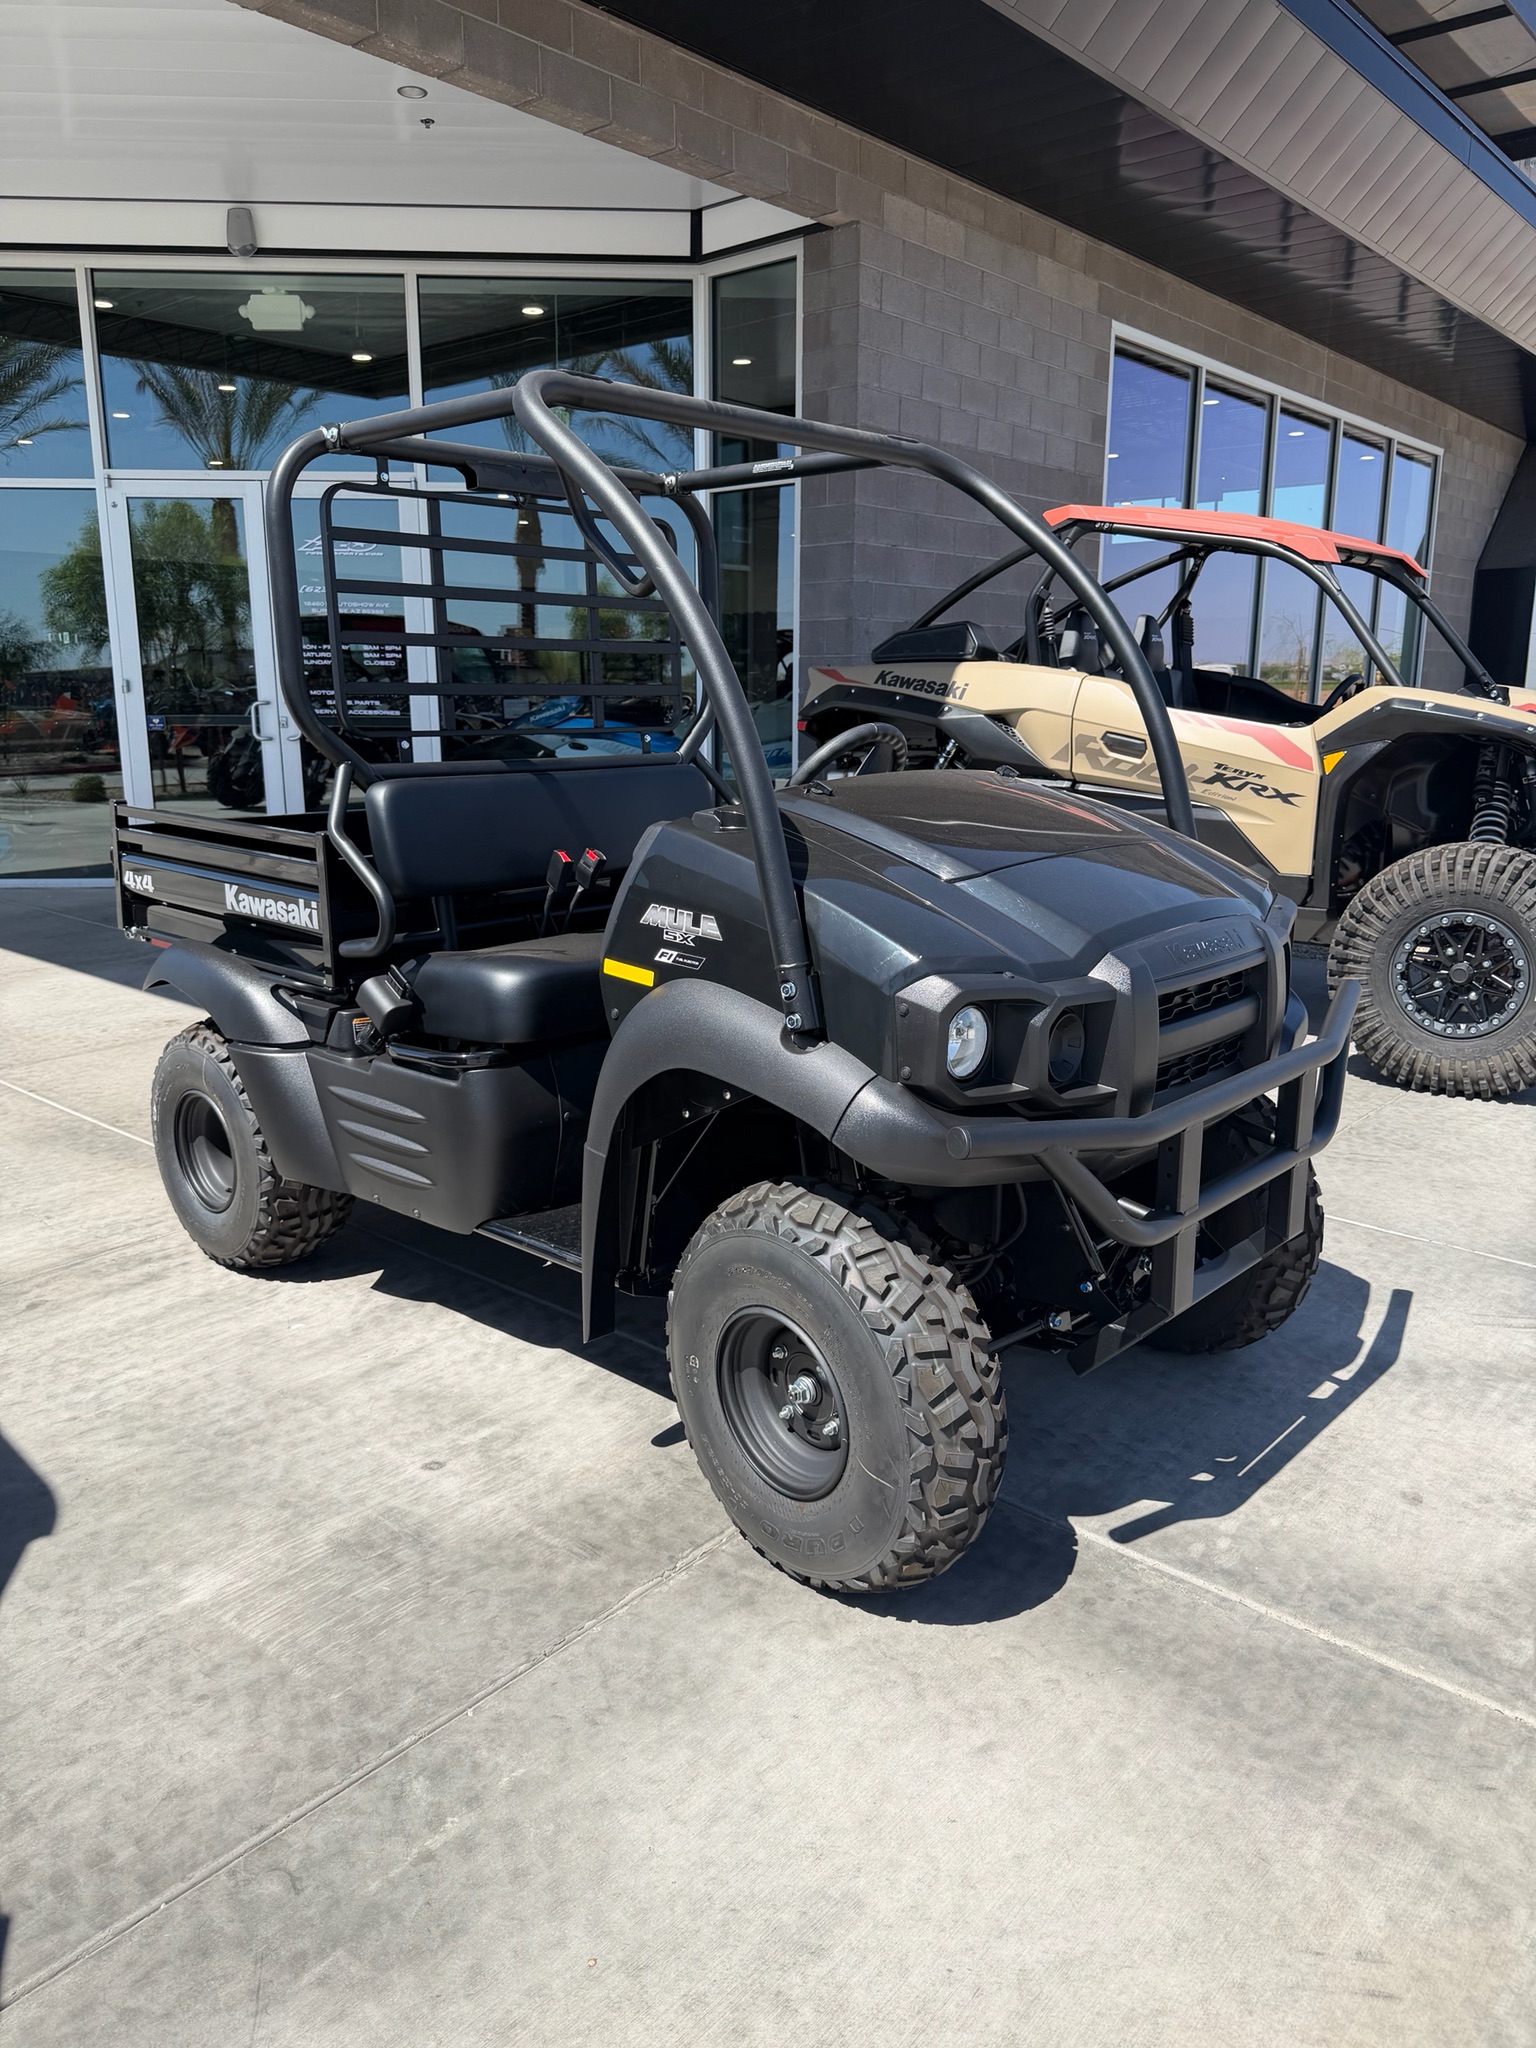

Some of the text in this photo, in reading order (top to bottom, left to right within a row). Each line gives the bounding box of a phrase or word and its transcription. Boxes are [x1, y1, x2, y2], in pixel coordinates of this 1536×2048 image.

[874, 670, 970, 700] Kawasaki
[1200, 771, 1307, 808] KRX
[123, 870, 155, 893] 4x4
[224, 883, 320, 930] Kawasaki
[640, 903, 723, 941] MULE
[663, 928, 696, 947] SX
[658, 950, 674, 961] FI
